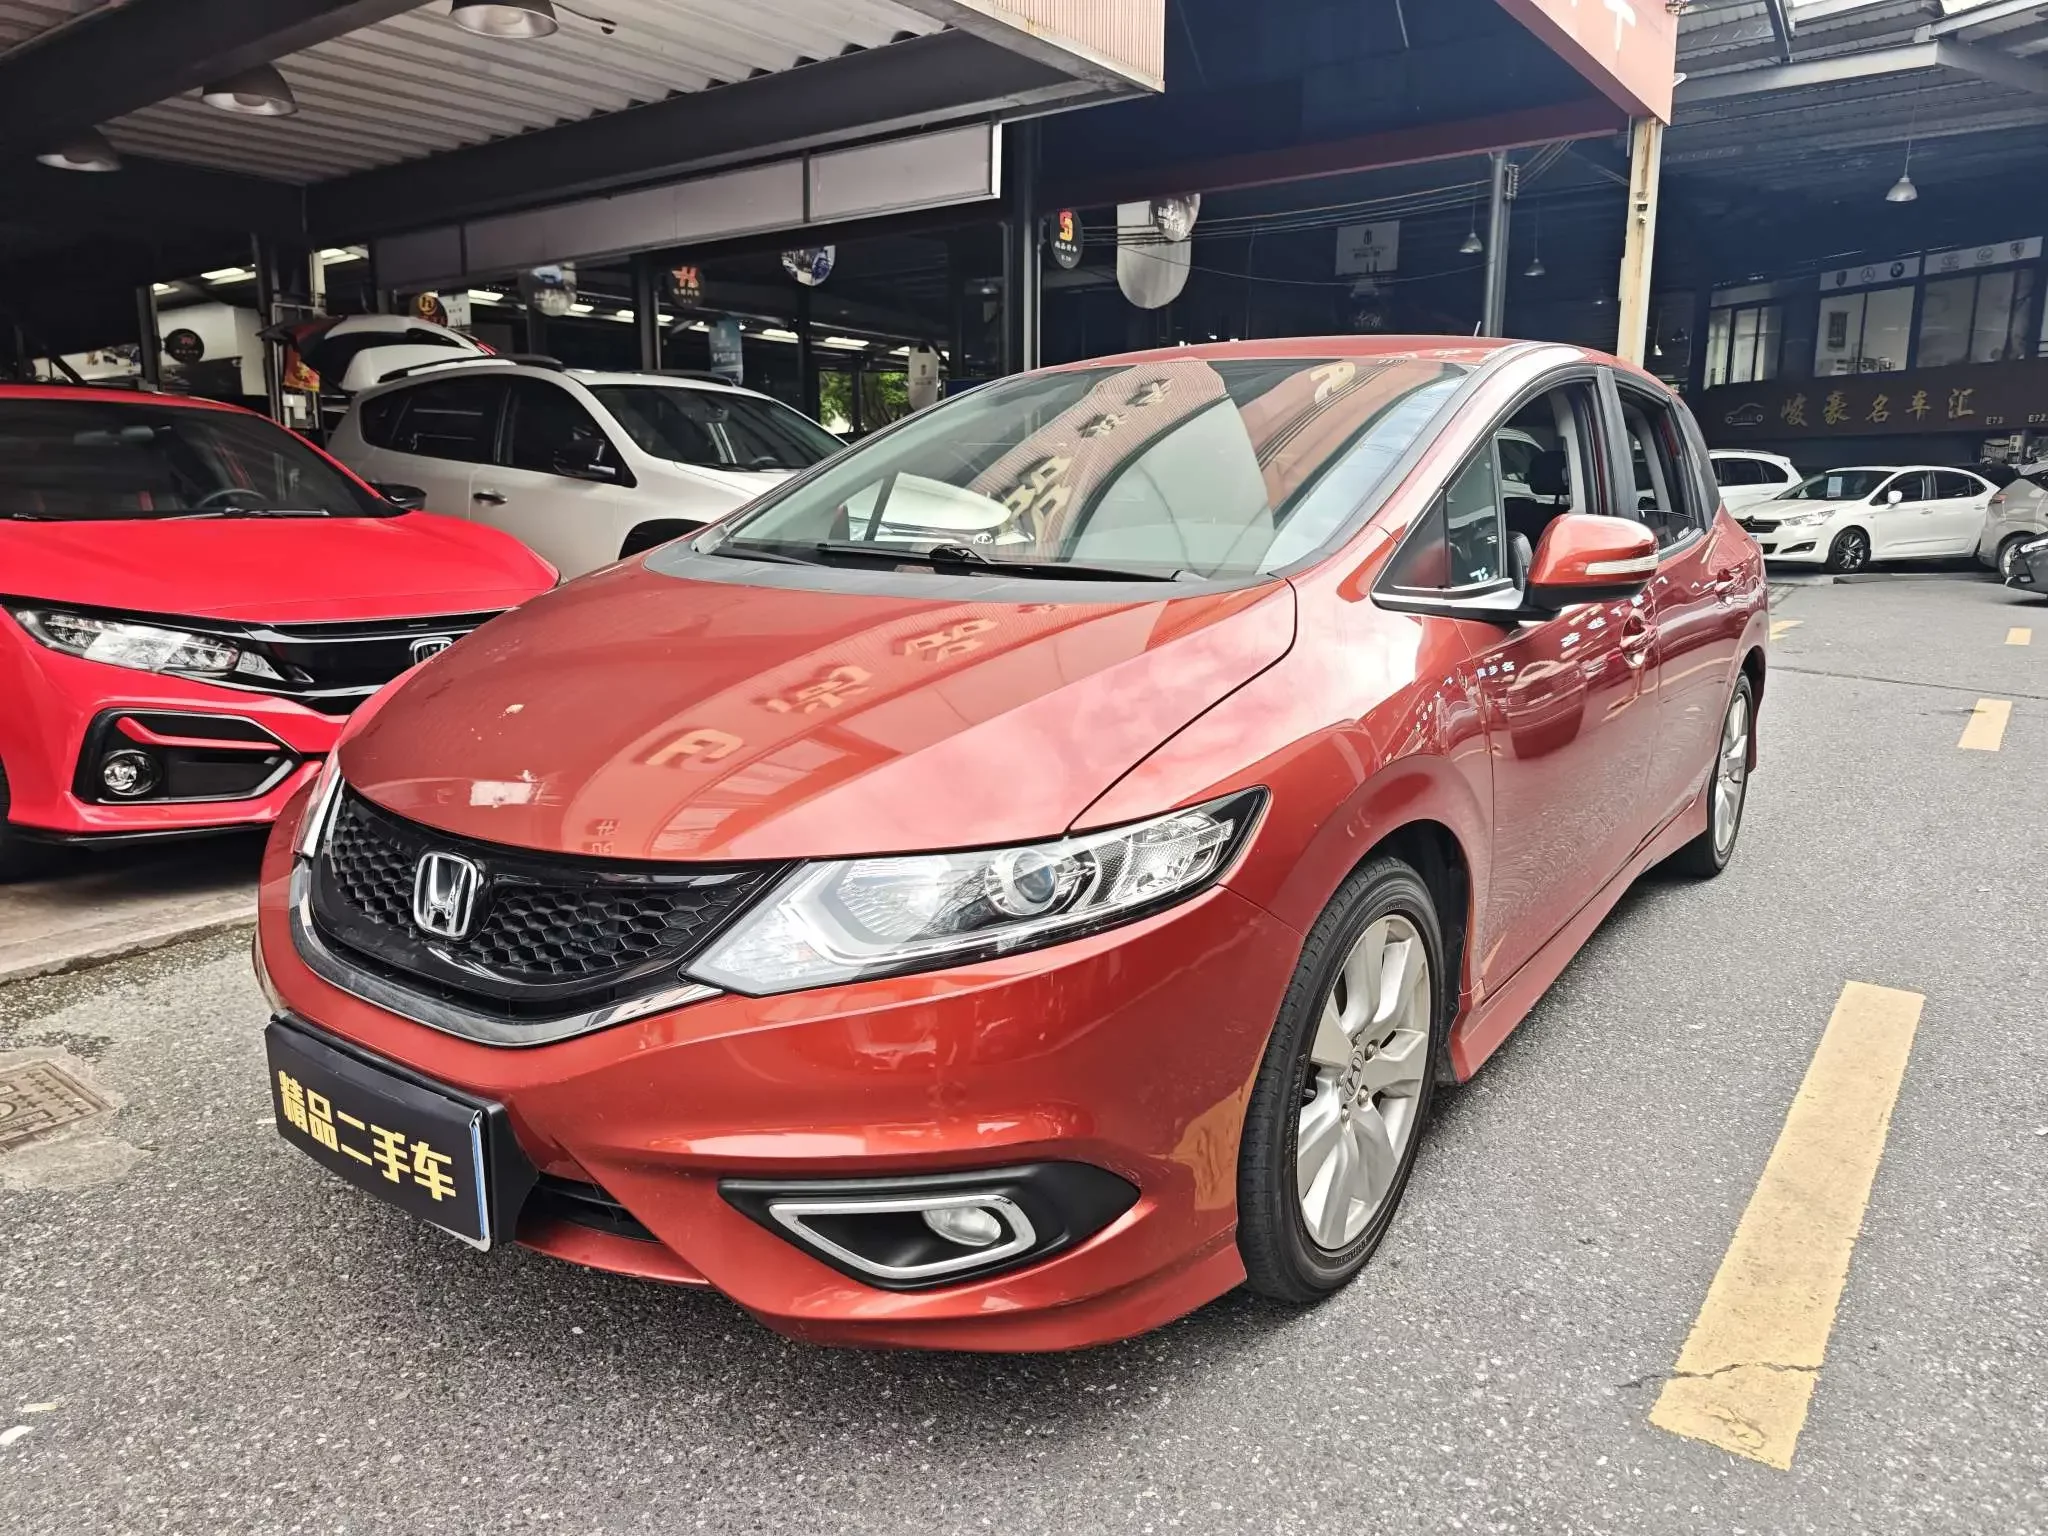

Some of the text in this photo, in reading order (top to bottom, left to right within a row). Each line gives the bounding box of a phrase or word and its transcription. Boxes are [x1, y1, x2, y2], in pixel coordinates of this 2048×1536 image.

[1781, 389, 1975, 427] 峻豪名车汇
[278, 1070, 457, 1202] 精品二手车
